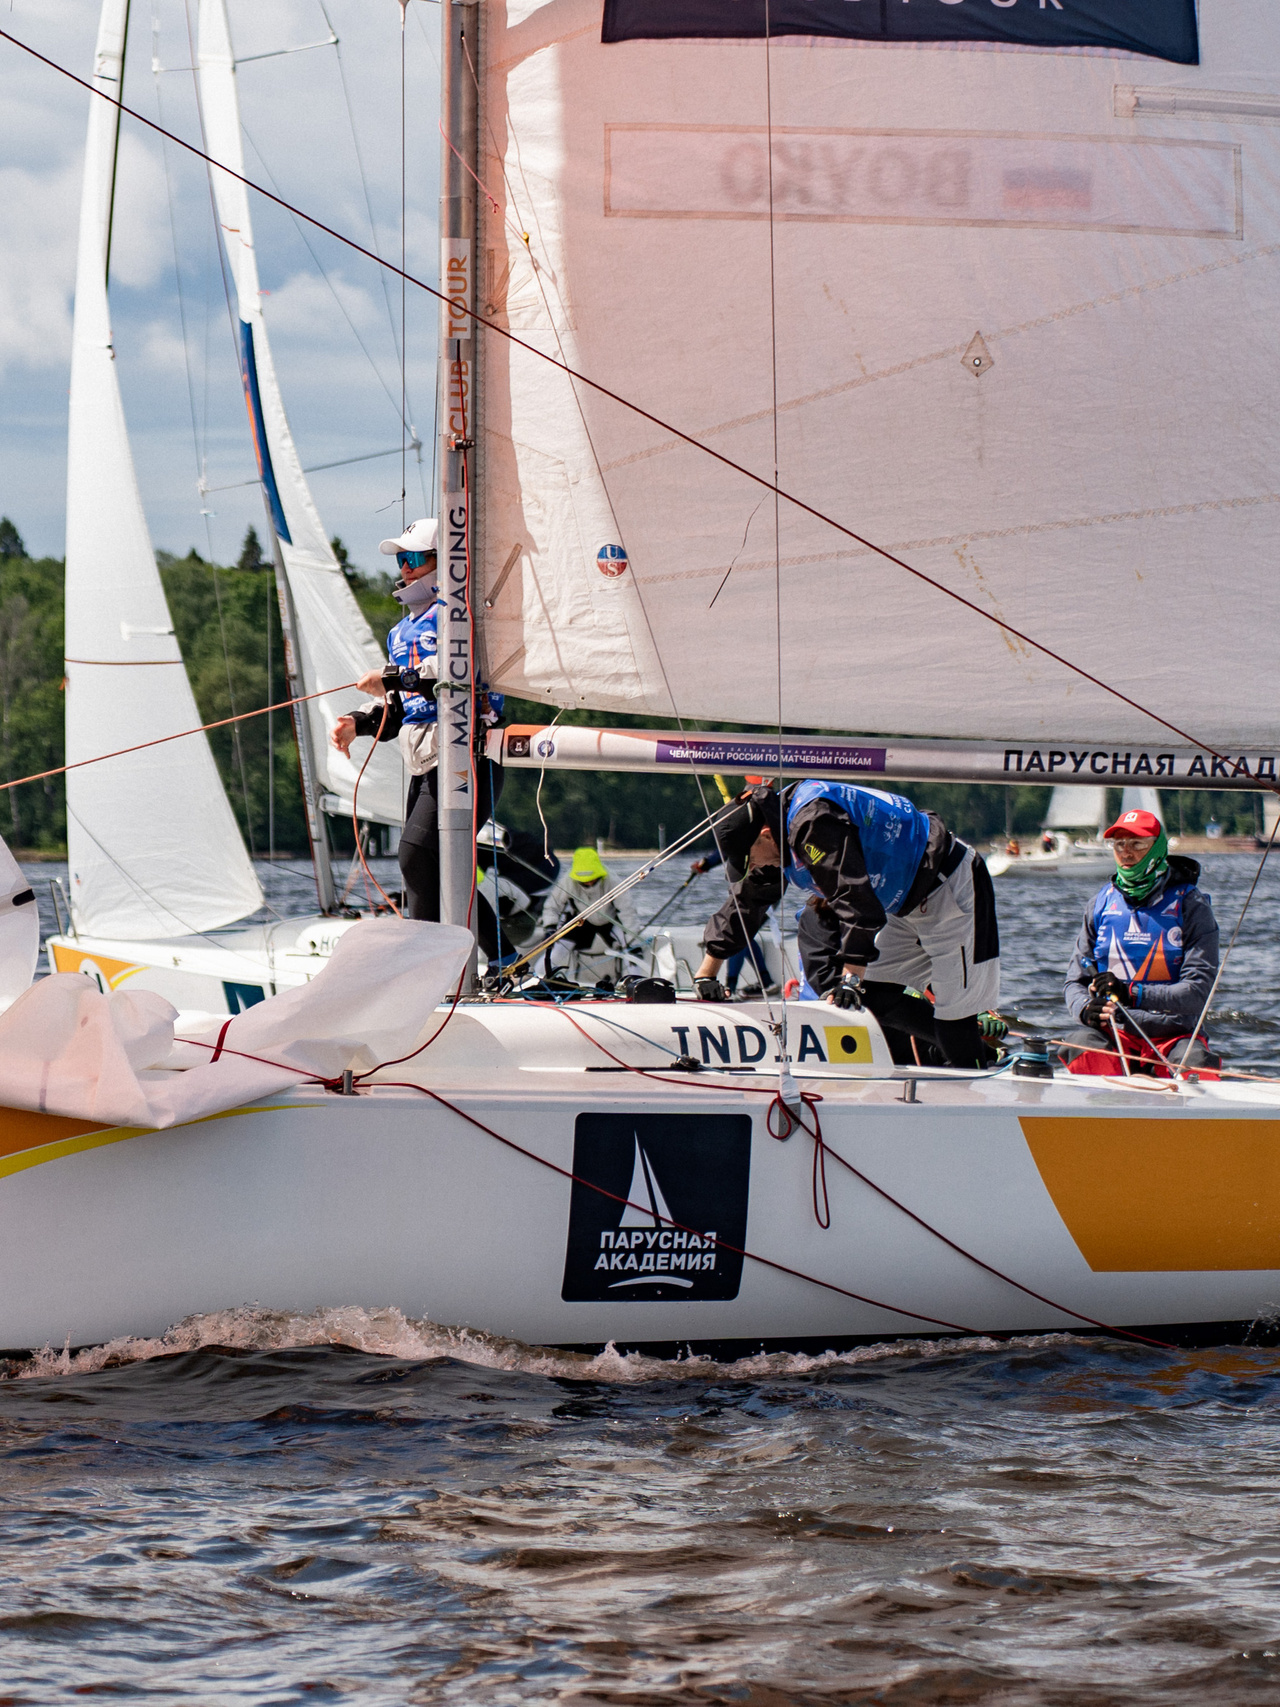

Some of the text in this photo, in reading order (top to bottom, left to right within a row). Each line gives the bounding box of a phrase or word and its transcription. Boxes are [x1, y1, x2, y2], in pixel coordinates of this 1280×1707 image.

[447, 255, 469, 747] MATCH RACING CLUB TOUR
[669, 749, 872, 766] ЧЕМПИОНАТ РОССИИ ПО МАТЧЕВЫМ ГОНКАМ
[1003, 750, 1277, 782] ПАРУСНАЯ АКАД
[600, 1231, 717, 1249] ПАРУСНАЯ
[593, 1253, 717, 1272] АКАДЕМИЯ
